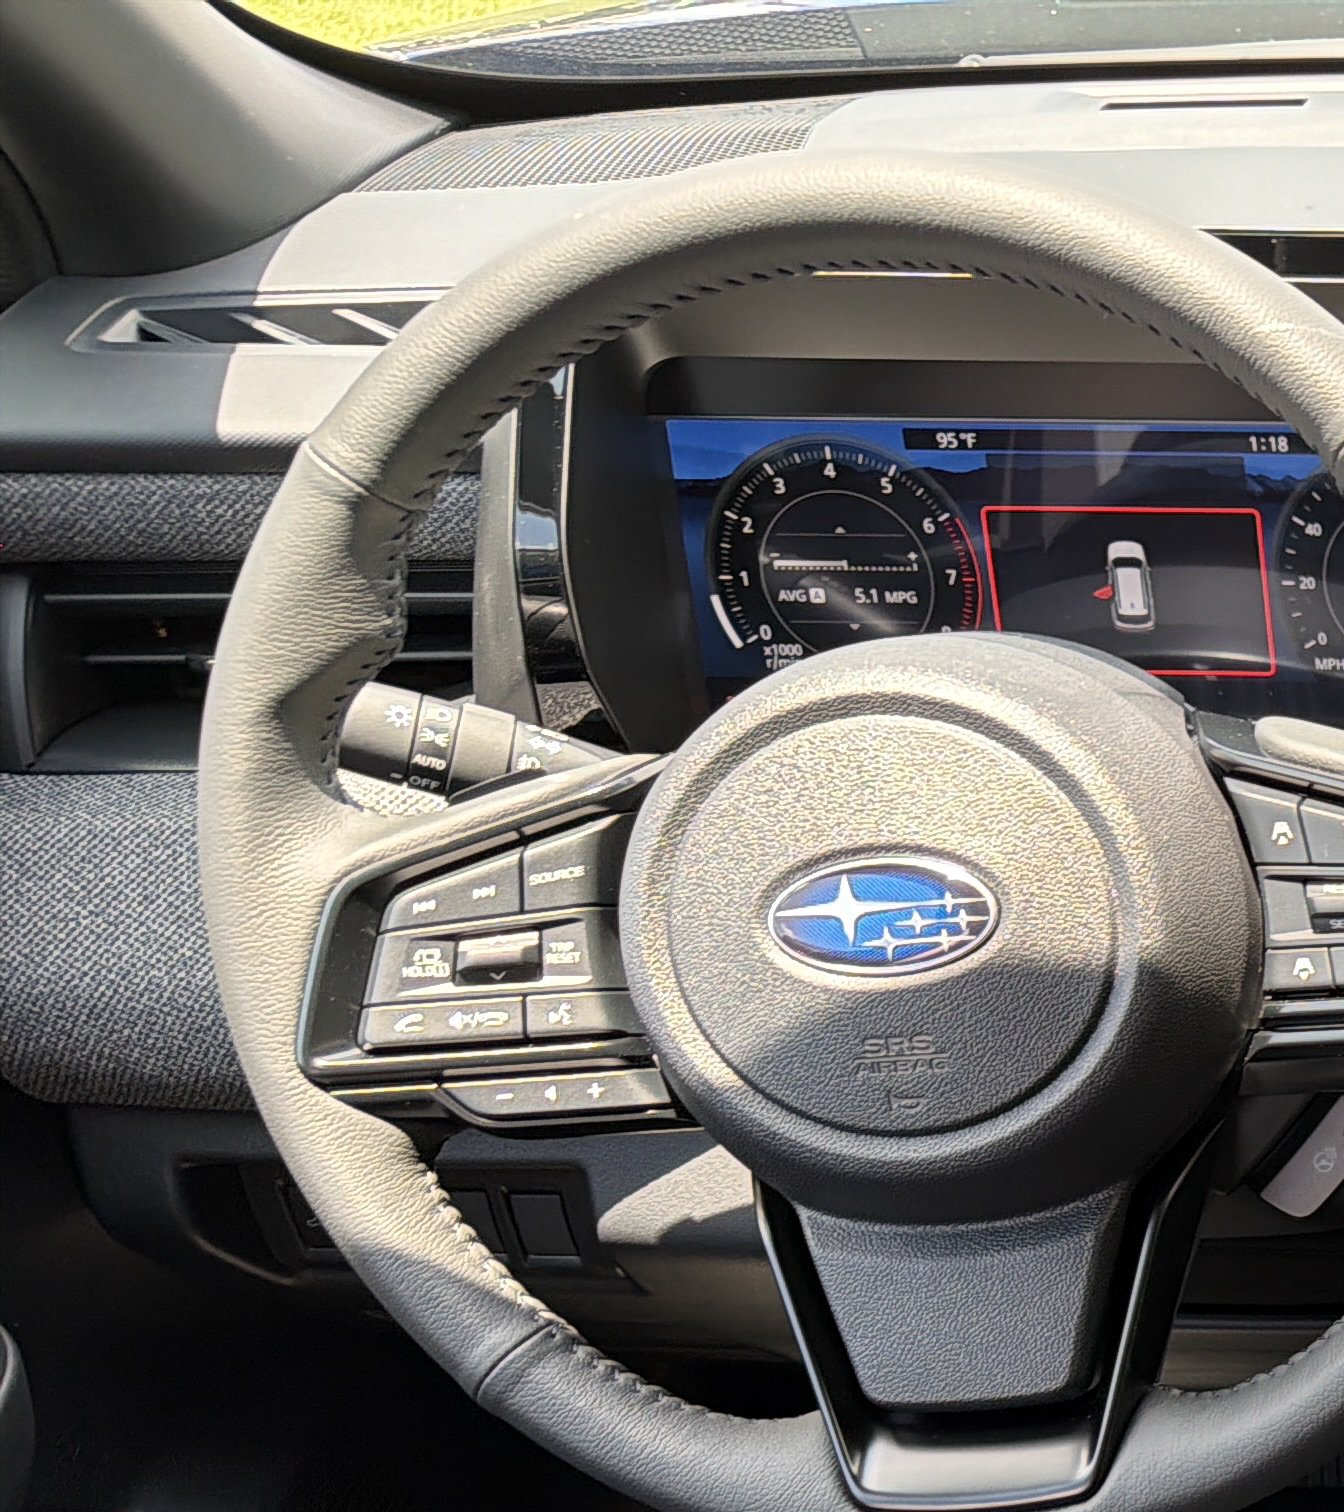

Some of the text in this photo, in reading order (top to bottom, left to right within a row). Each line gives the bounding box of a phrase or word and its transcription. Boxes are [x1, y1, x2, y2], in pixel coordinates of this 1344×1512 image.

[935, 432, 977, 449] 95°F
[1249, 435, 1289, 453] 1:18
[823, 462, 836, 478] 4
[773, 478, 786, 494] 3
[881, 477, 893, 494] 5
[742, 517, 754, 534] 2
[923, 517, 935, 534] 6
[1305, 523, 1323, 537] 40
[739, 571, 749, 587] 1
[945, 569, 957, 585] 7
[1299, 576, 1316, 590] 20
[778, 588, 807, 603] AVG
[854, 588, 879, 604] 5.1
[884, 590, 918, 604] MPG
[759, 625, 772, 641] 0
[1317, 632, 1328, 646] 0
[411, 753, 447, 771] AUTO
[409, 774, 442, 790] OFF
[528, 864, 586, 887] SOURCE
[863, 1034, 936, 1058] SRS
[852, 1059, 950, 1077] AIRBAG
